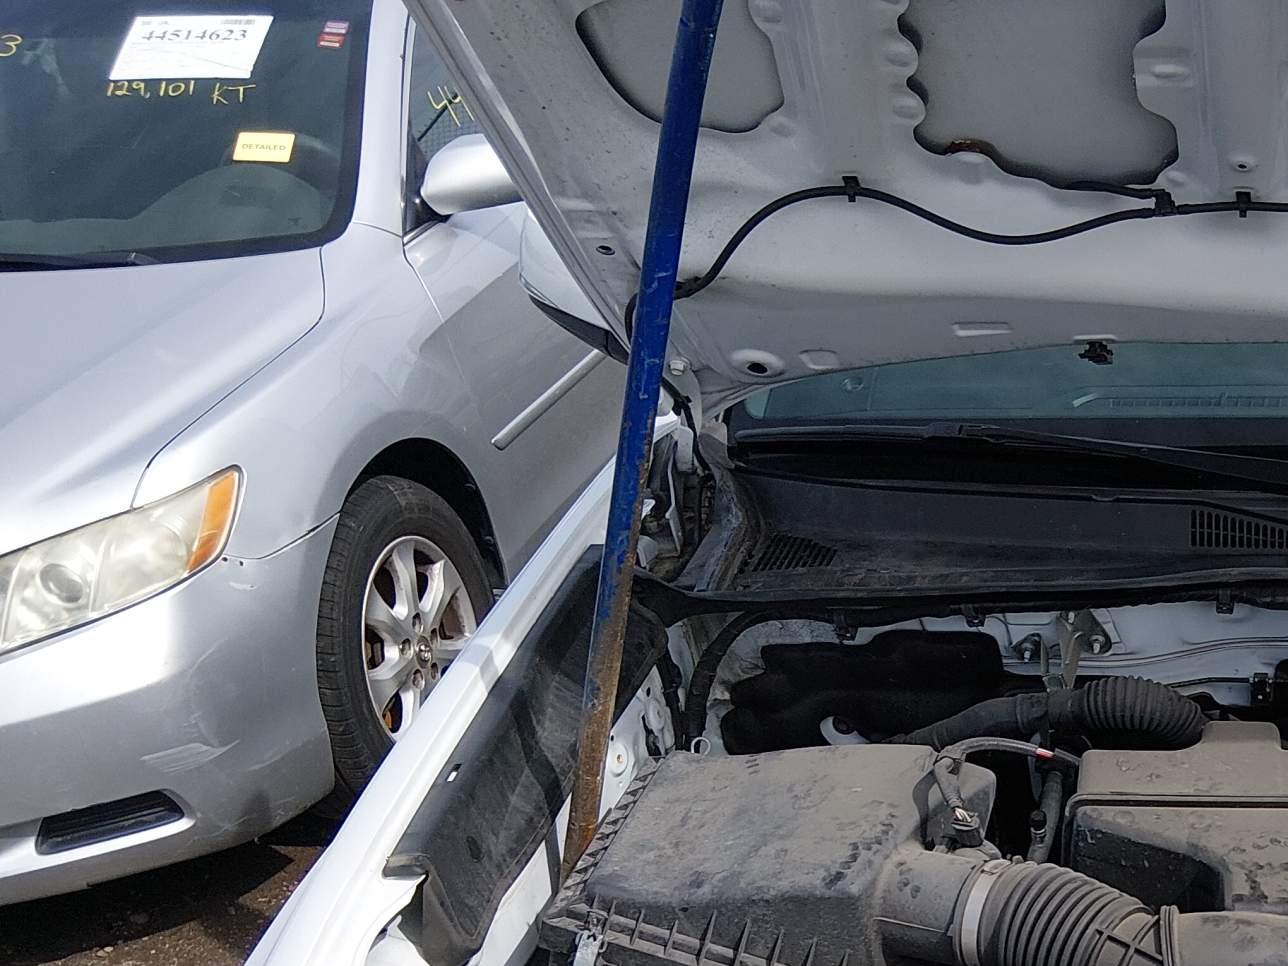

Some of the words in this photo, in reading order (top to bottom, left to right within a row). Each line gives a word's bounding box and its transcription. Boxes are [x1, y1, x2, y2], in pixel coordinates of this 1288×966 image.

[142, 29, 248, 41] 44514623
[211, 83, 256, 105] KT
[241, 143, 286, 151] DETAILED
